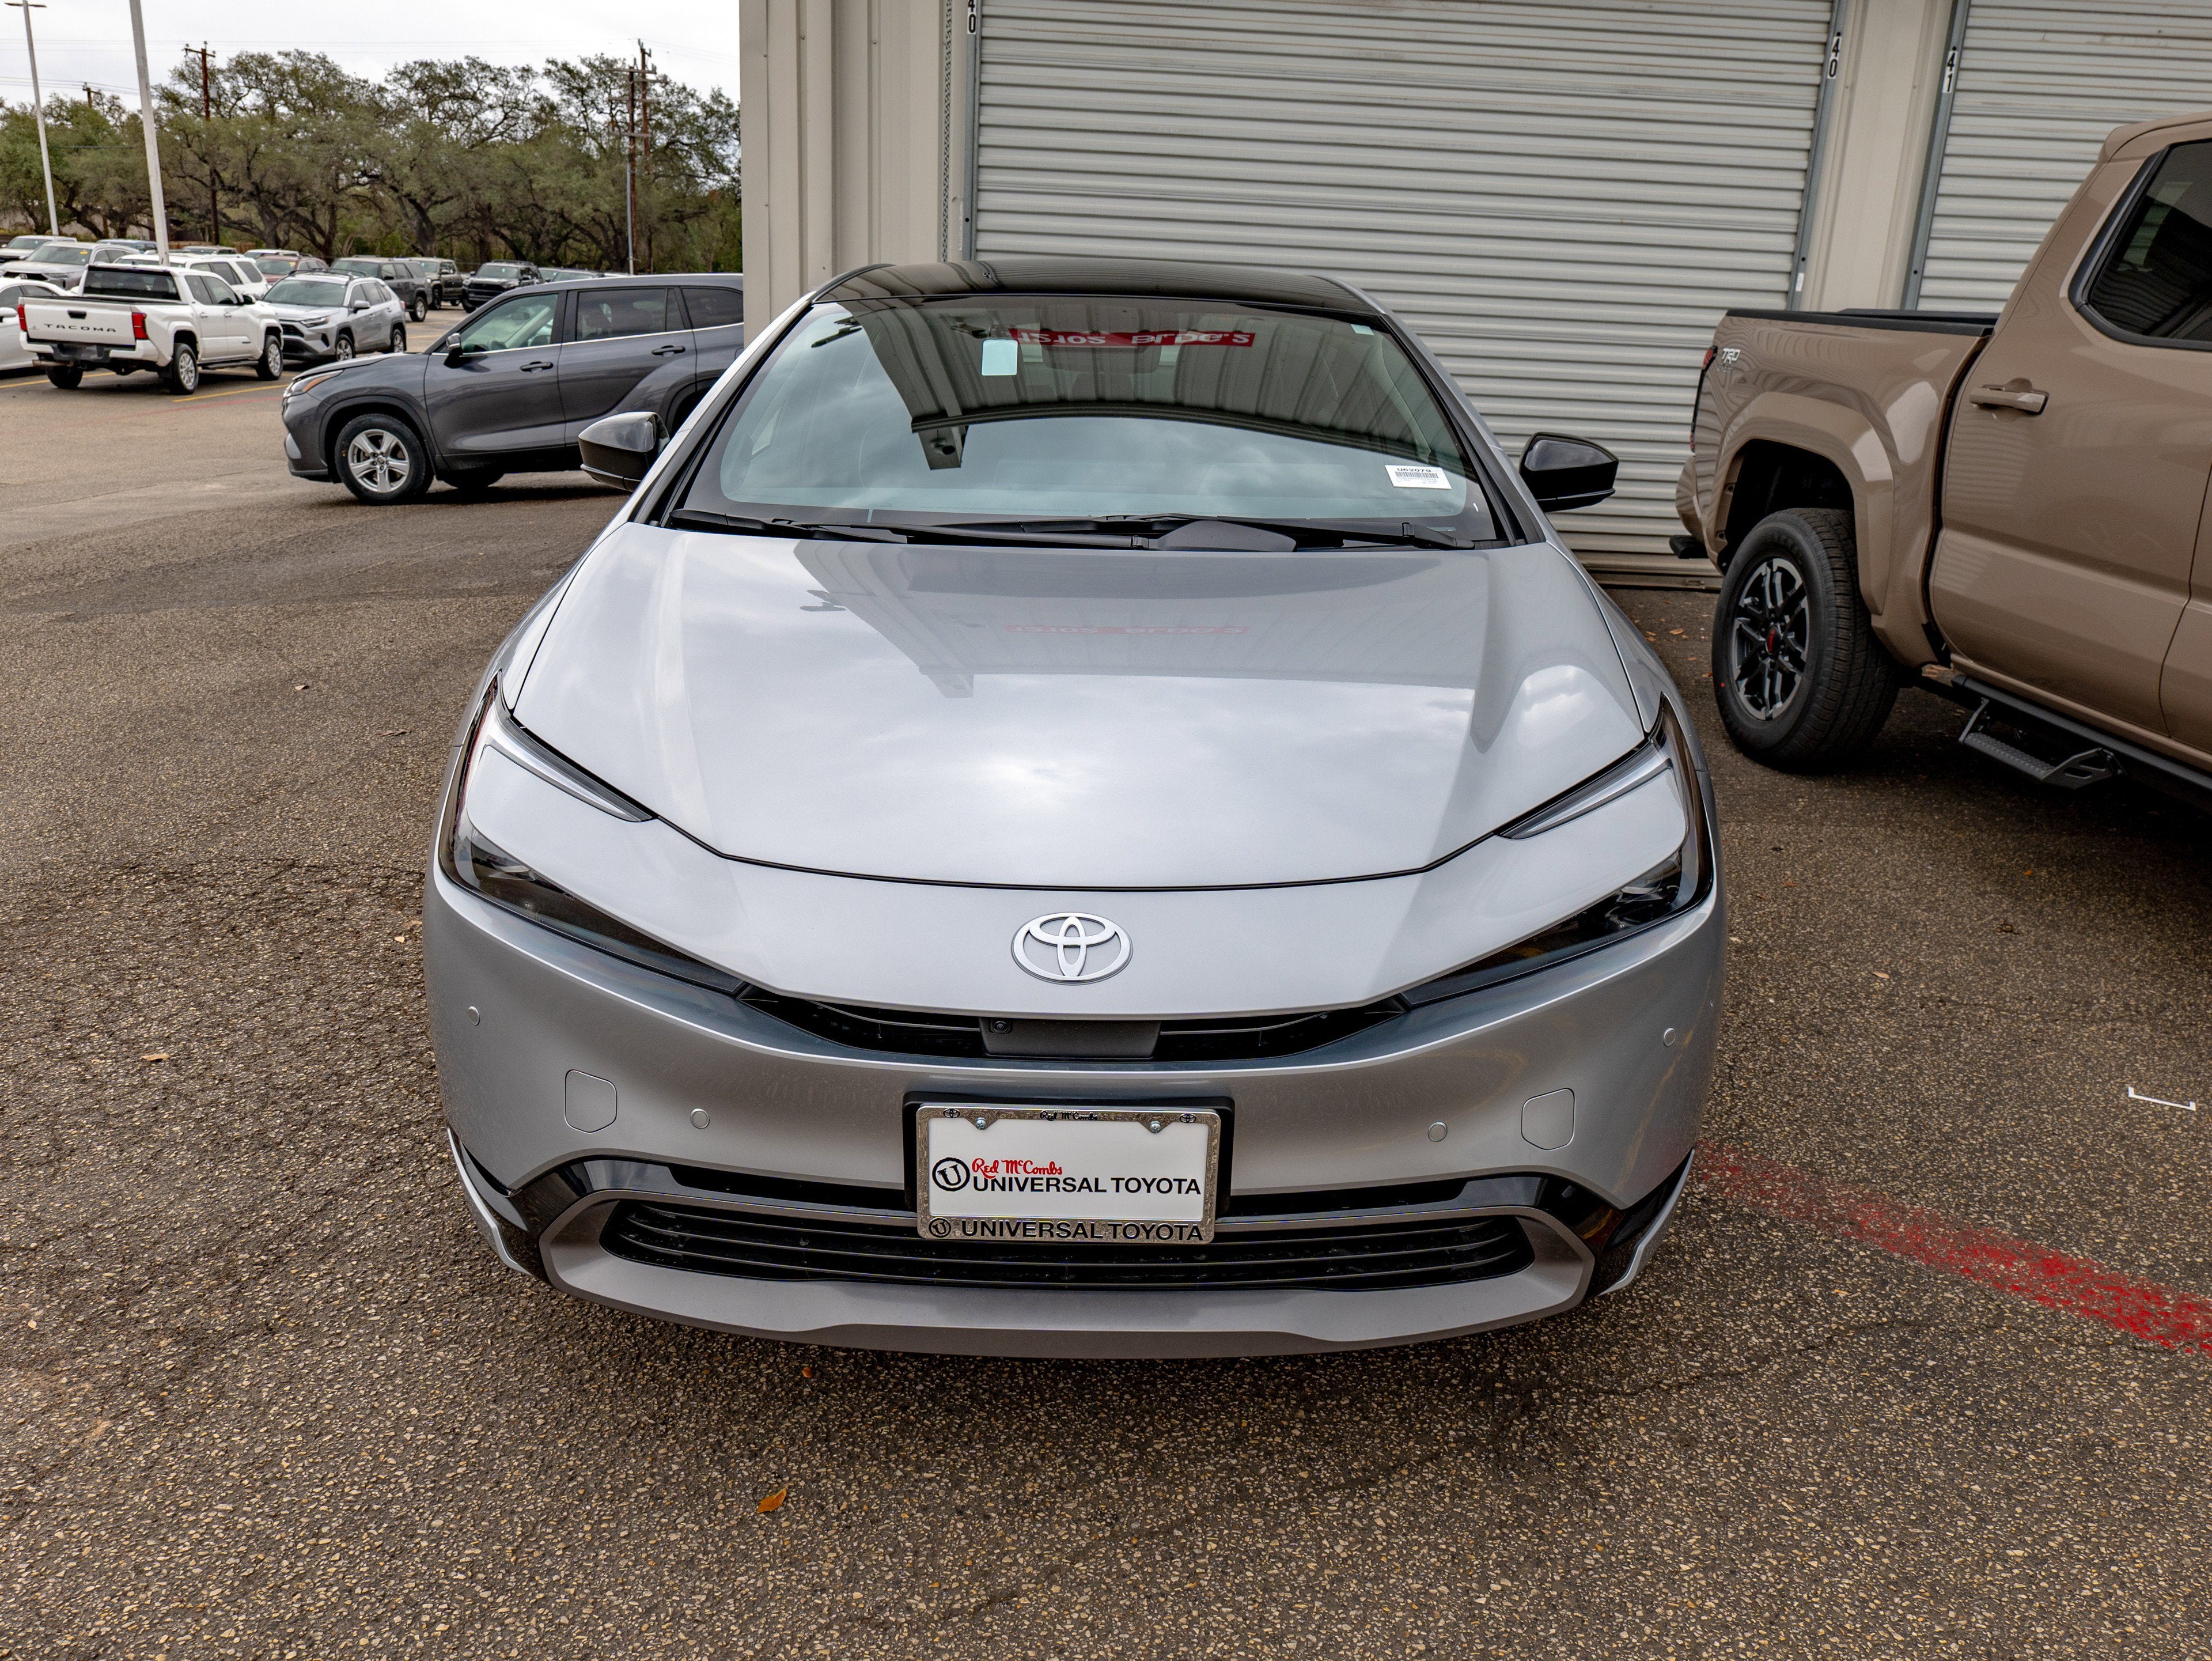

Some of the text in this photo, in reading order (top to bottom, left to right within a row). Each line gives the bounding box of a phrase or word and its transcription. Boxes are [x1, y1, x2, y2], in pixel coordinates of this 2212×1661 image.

[968, 0, 976, 33] 40
[1829, 38, 1840, 77] 40
[1947, 52, 1955, 92] 41
[44, 323, 117, 332] TACOMA
[1722, 348, 1740, 364] TRD
[1040, 1110, 1058, 1121] Red
[972, 1158, 1063, 1179] Red McCombs
[974, 1176, 1201, 1194] UNIVERSAL TOYOTA
[961, 1220, 1103, 1239] UNIVERSAL
[1107, 1222, 1203, 1241] TOYOTA
